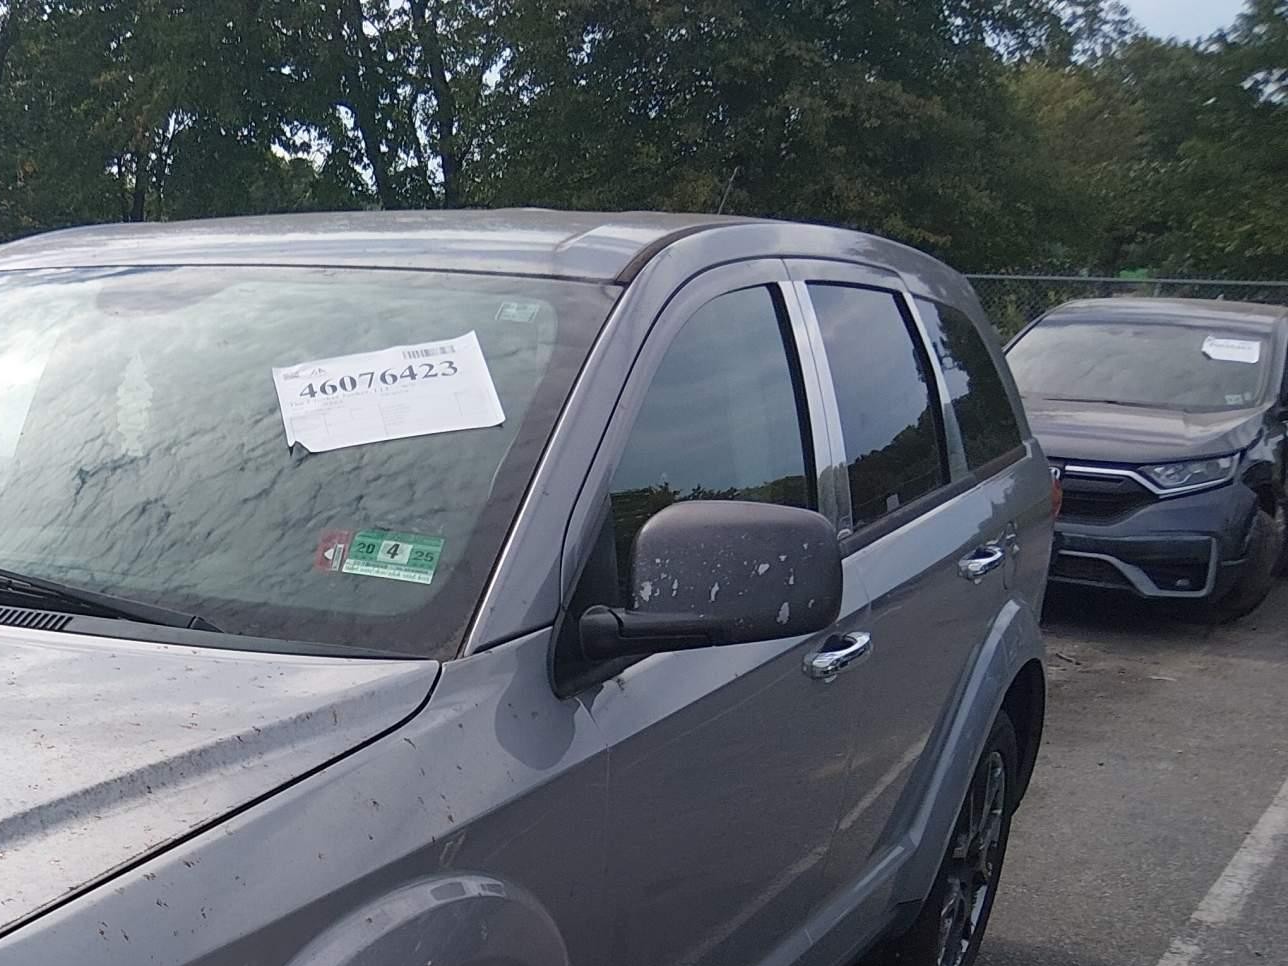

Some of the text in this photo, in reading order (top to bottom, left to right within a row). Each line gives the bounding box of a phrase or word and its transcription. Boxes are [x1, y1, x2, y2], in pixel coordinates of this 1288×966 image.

[299, 360, 458, 398] 46076423
[357, 542, 434, 562] 20 4 25
